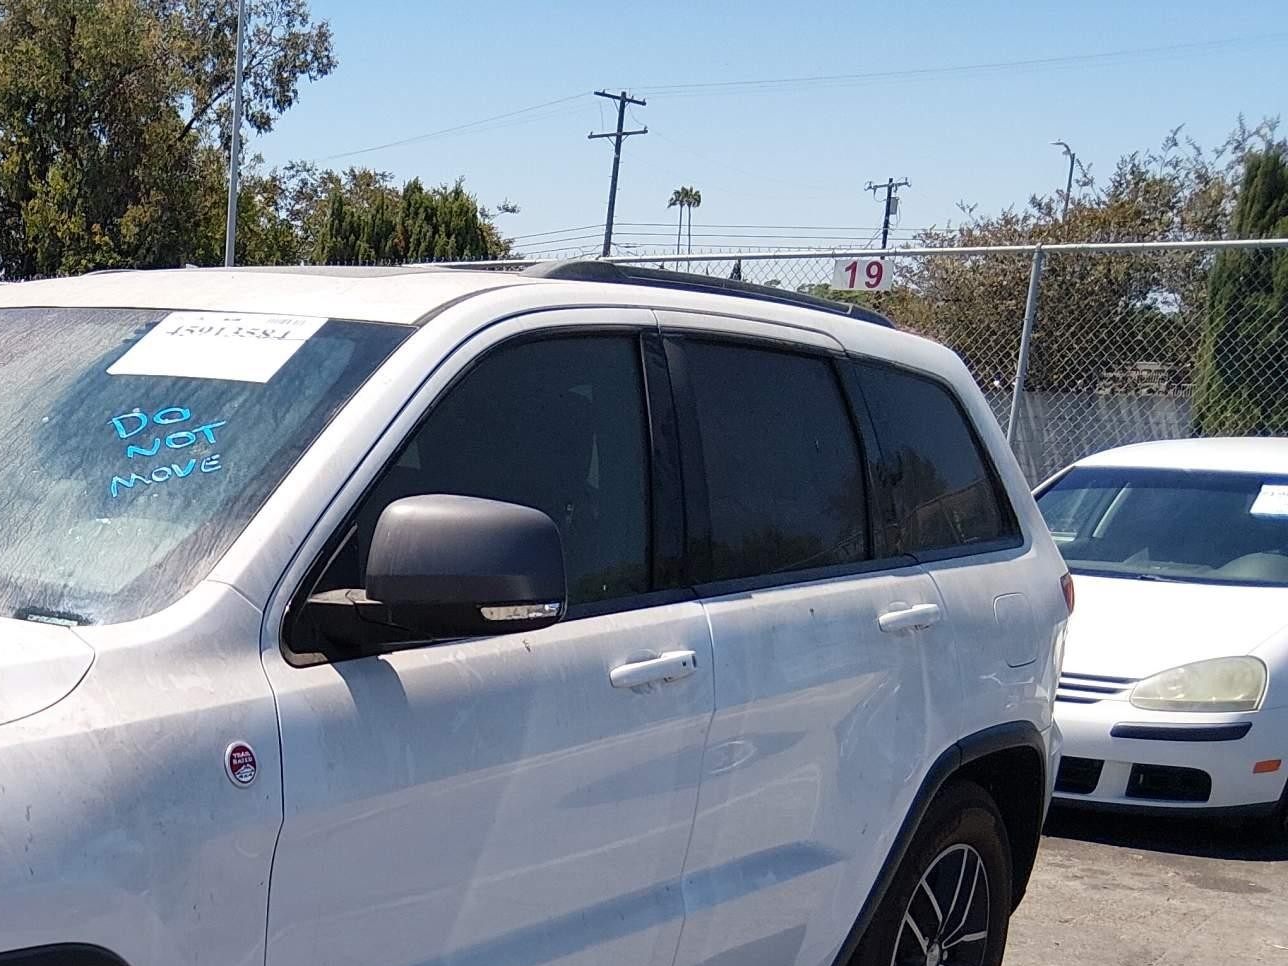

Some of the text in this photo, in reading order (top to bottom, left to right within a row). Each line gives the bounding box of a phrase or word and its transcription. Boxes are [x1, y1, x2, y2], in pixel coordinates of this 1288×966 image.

[844, 260, 884, 289] 19
[107, 406, 192, 440] DO
[127, 420, 227, 458] NOT
[110, 453, 223, 498] MOVE
